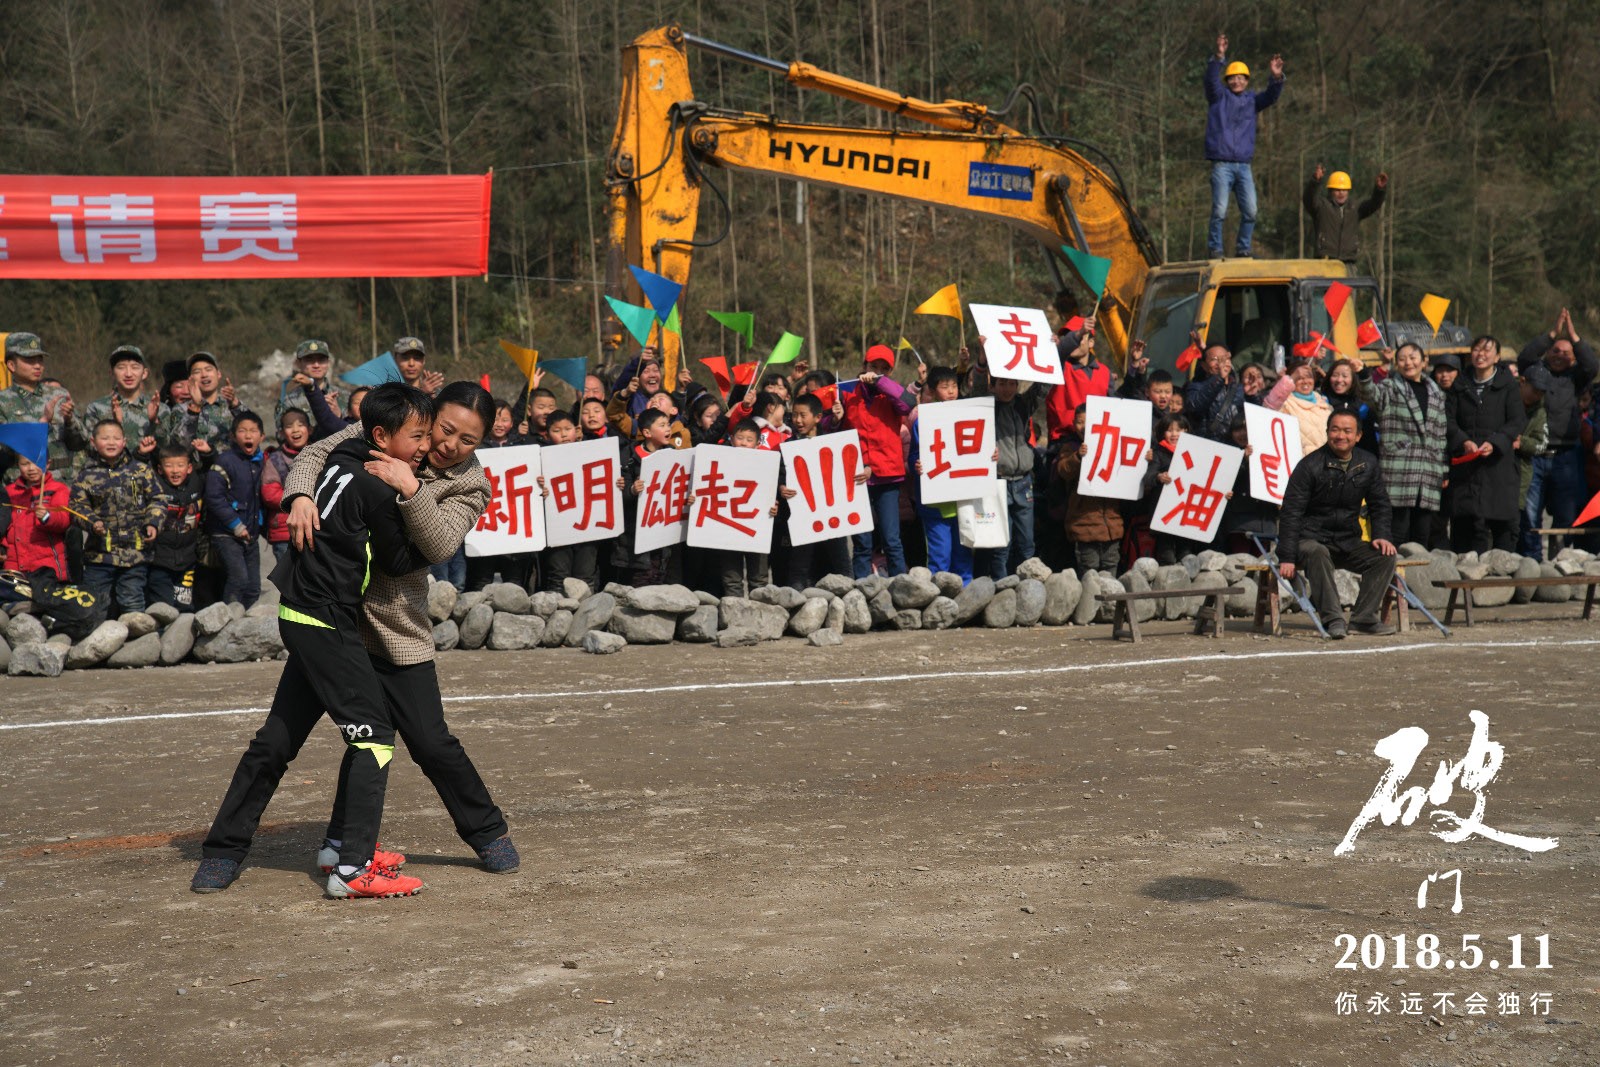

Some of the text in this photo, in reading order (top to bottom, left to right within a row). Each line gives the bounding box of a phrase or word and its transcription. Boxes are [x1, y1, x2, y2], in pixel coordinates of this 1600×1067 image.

[769, 138, 930, 180] HYUNDAI
[0, 191, 299, 263] 请赛
[998, 313, 1054, 374] 克
[927, 418, 989, 479] 坦
[1087, 411, 1146, 483] 加
[313, 464, 354, 520] 11
[475, 463, 533, 538] 新
[550, 458, 614, 531] 明
[695, 461, 758, 537] 起
[1161, 450, 1224, 532] 油
